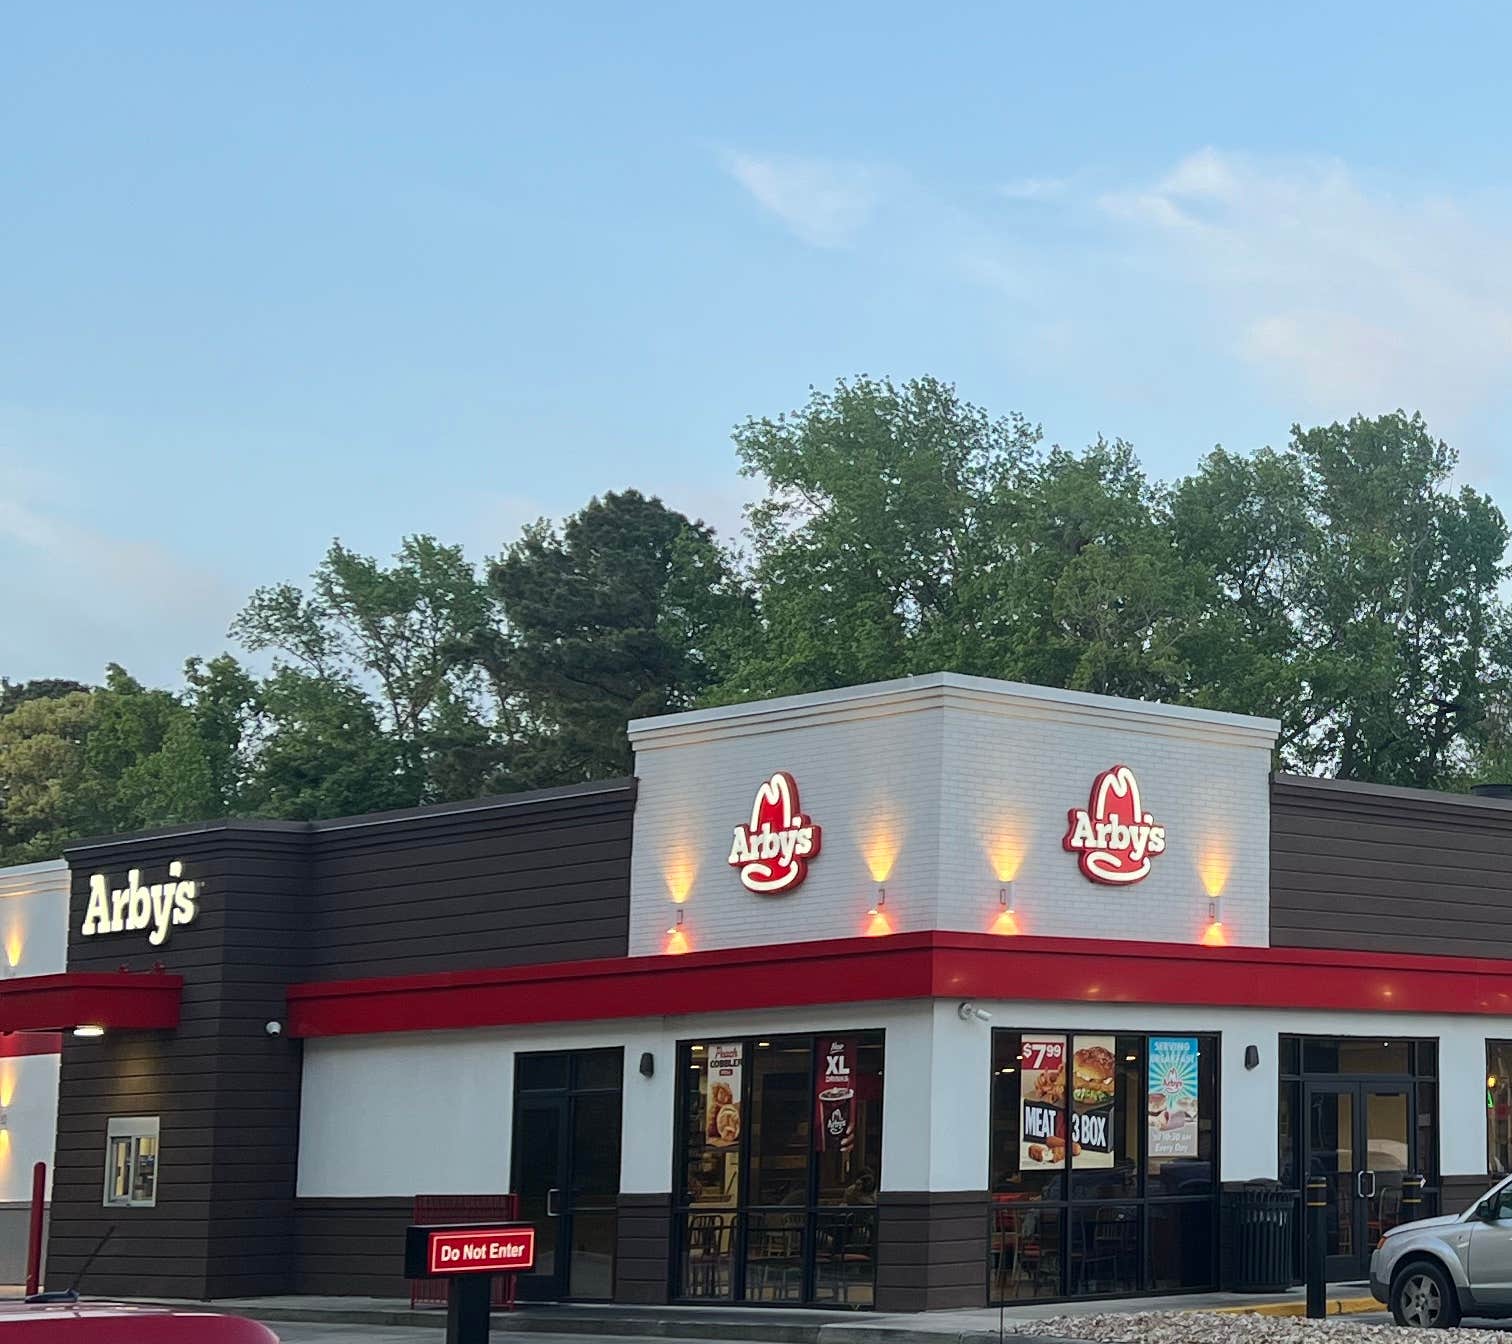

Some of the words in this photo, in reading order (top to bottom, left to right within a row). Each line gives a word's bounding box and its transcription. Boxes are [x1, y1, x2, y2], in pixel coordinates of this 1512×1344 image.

[728, 816, 812, 867] Arby's
[1071, 810, 1165, 861] Arby's
[82, 861, 195, 945] Arby's
[826, 1055, 850, 1075] XL
[1025, 1106, 1057, 1138] MEAT
[1072, 1113, 1080, 1142] 3
[1081, 1114, 1107, 1147] BOX
[441, 1245, 460, 1262] Do
[462, 1243, 487, 1260] Not
[489, 1242, 526, 1259] Enter
